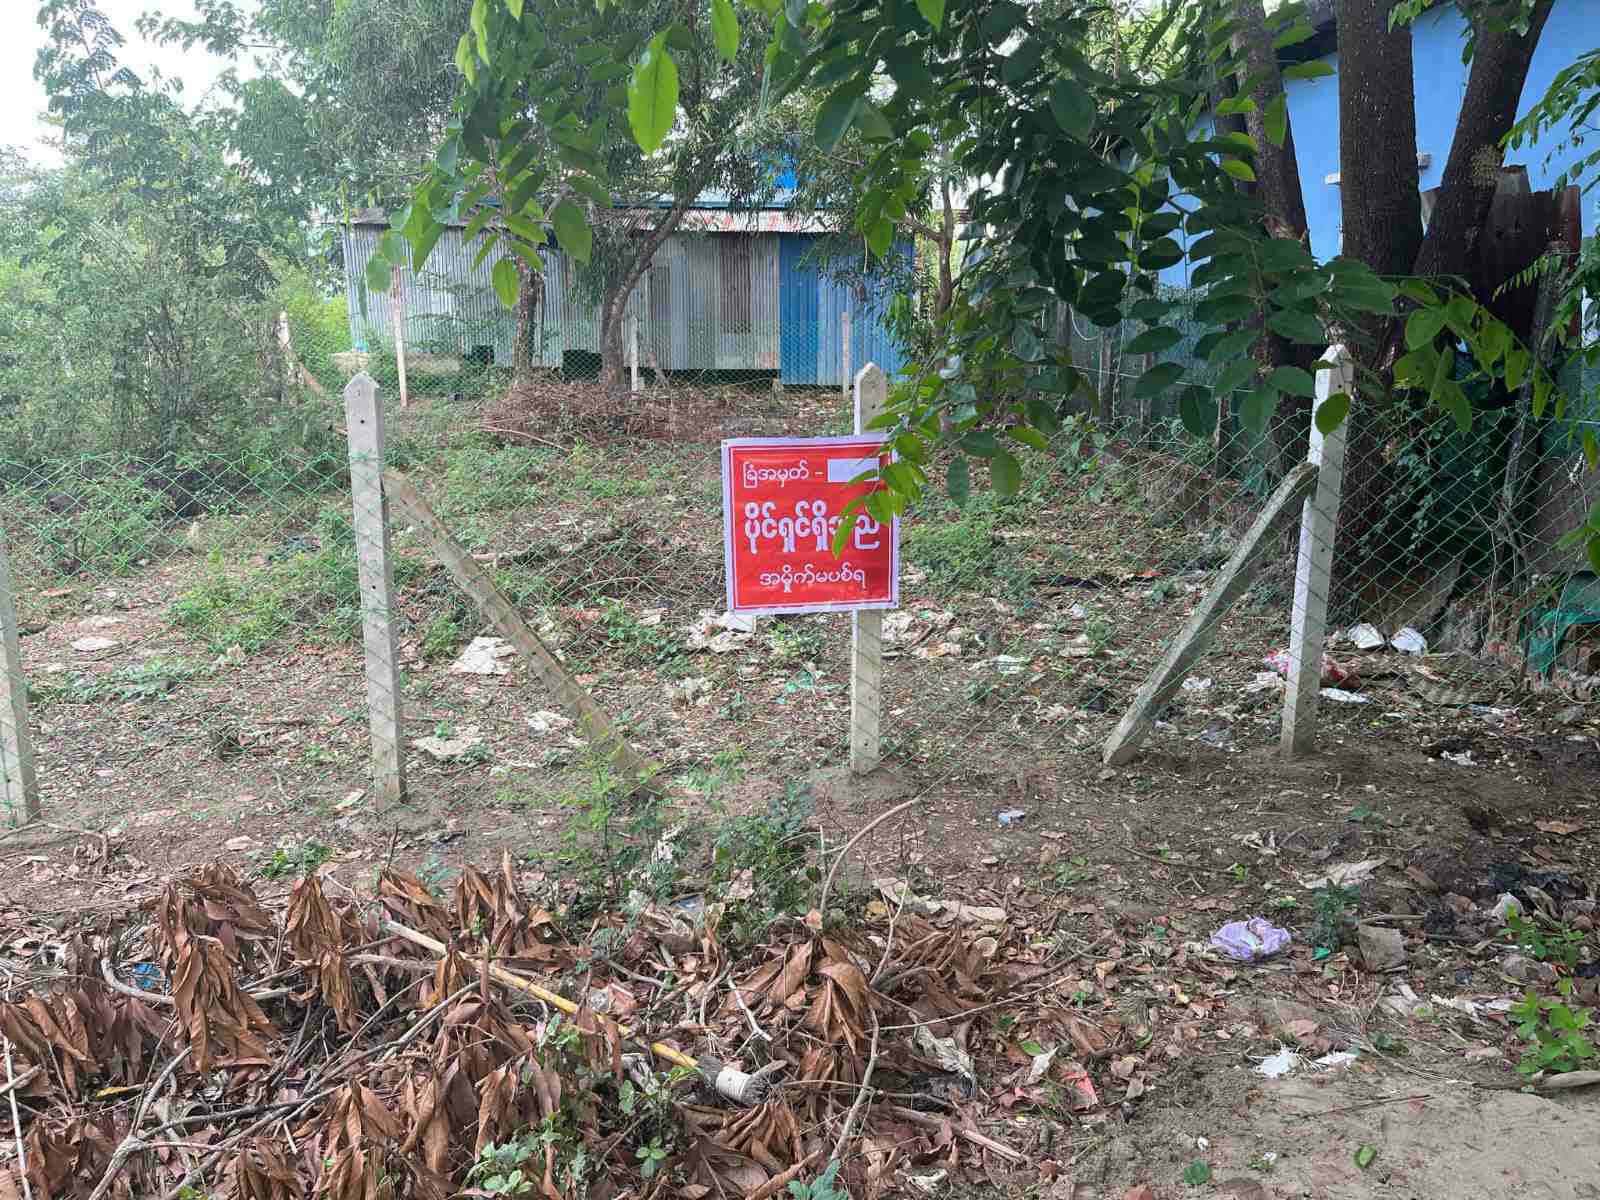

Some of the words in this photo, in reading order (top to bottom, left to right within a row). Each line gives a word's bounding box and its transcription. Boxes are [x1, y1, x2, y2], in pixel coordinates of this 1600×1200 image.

[743, 460, 809, 488] ခြံအမှတ်
[744, 500, 880, 554] ပိုင်ရှင်ရှိည
[760, 562, 865, 592] အမှိုက်မပစ်ရ
